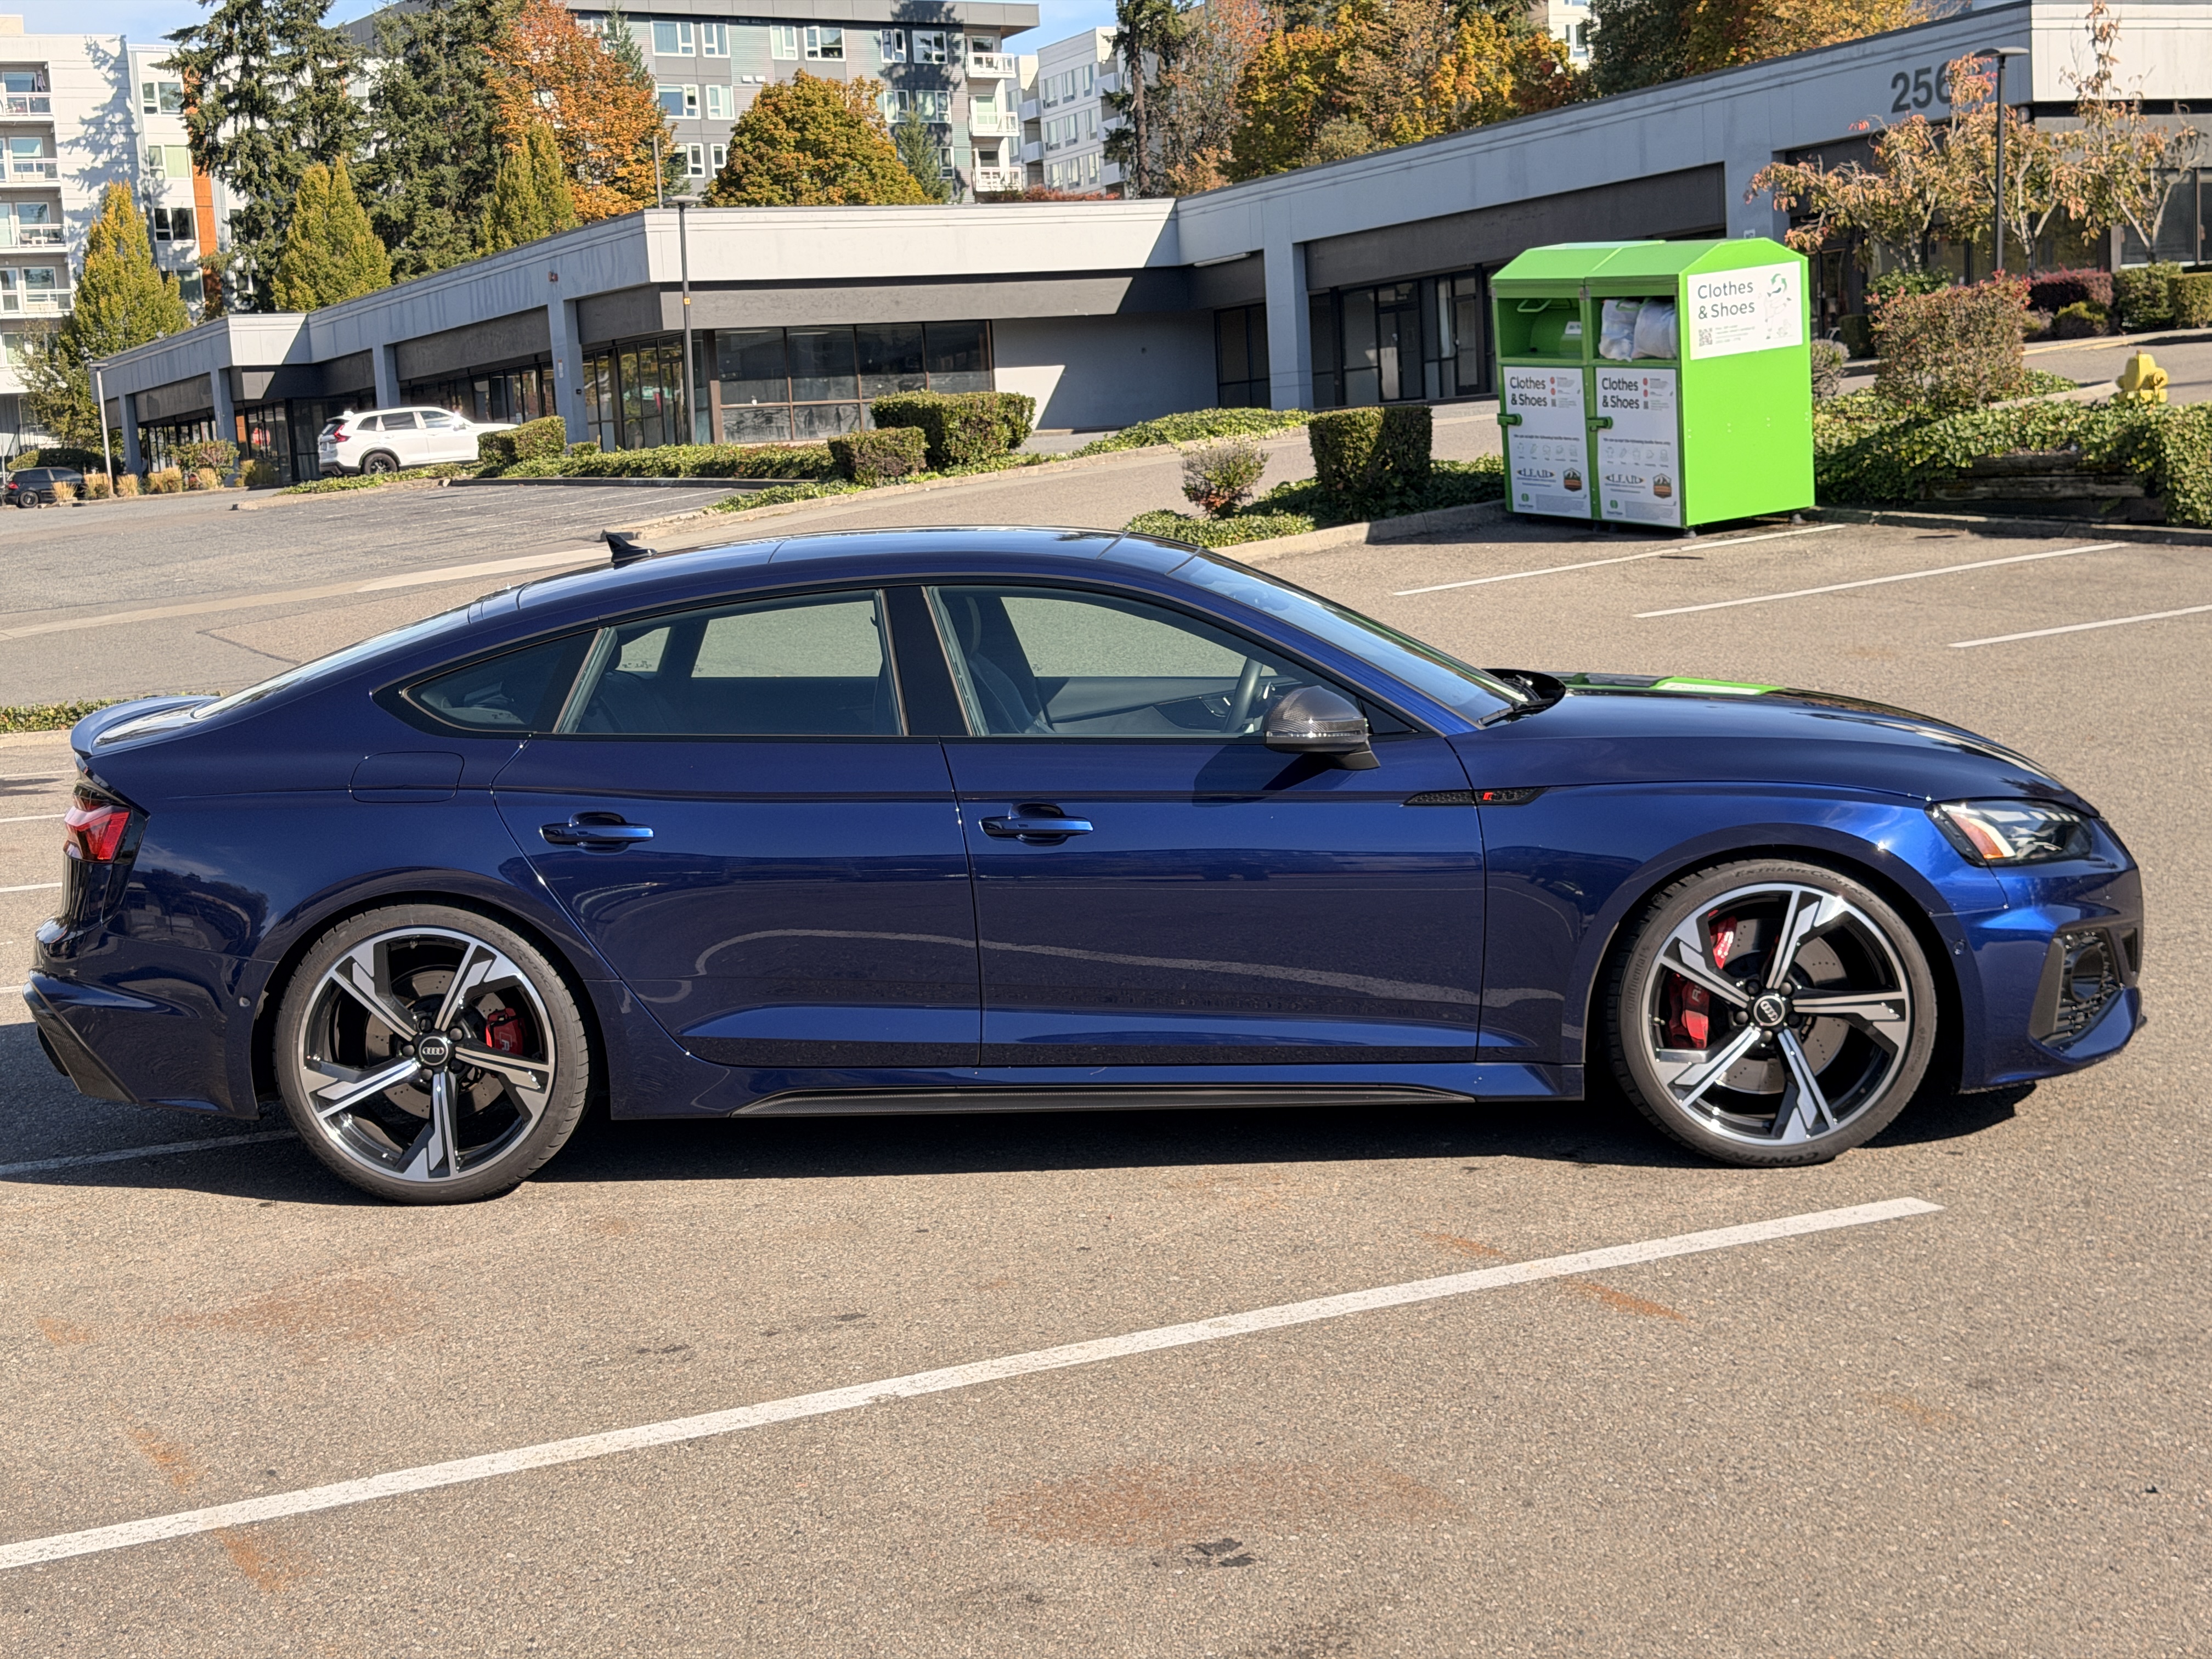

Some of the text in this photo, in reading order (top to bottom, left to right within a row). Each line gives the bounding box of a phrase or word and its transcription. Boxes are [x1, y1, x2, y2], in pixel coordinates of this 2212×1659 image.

[1697, 281, 1754, 299] Clothes
[1698, 302, 1755, 319] & Shoes
[1510, 376, 1547, 390] Clothes
[1601, 377, 1639, 392] Clothes
[1510, 393, 1517, 405] &
[1519, 393, 1548, 407] Shoes
[1602, 395, 1609, 408] &
[1610, 394, 1640, 409] Shoes
